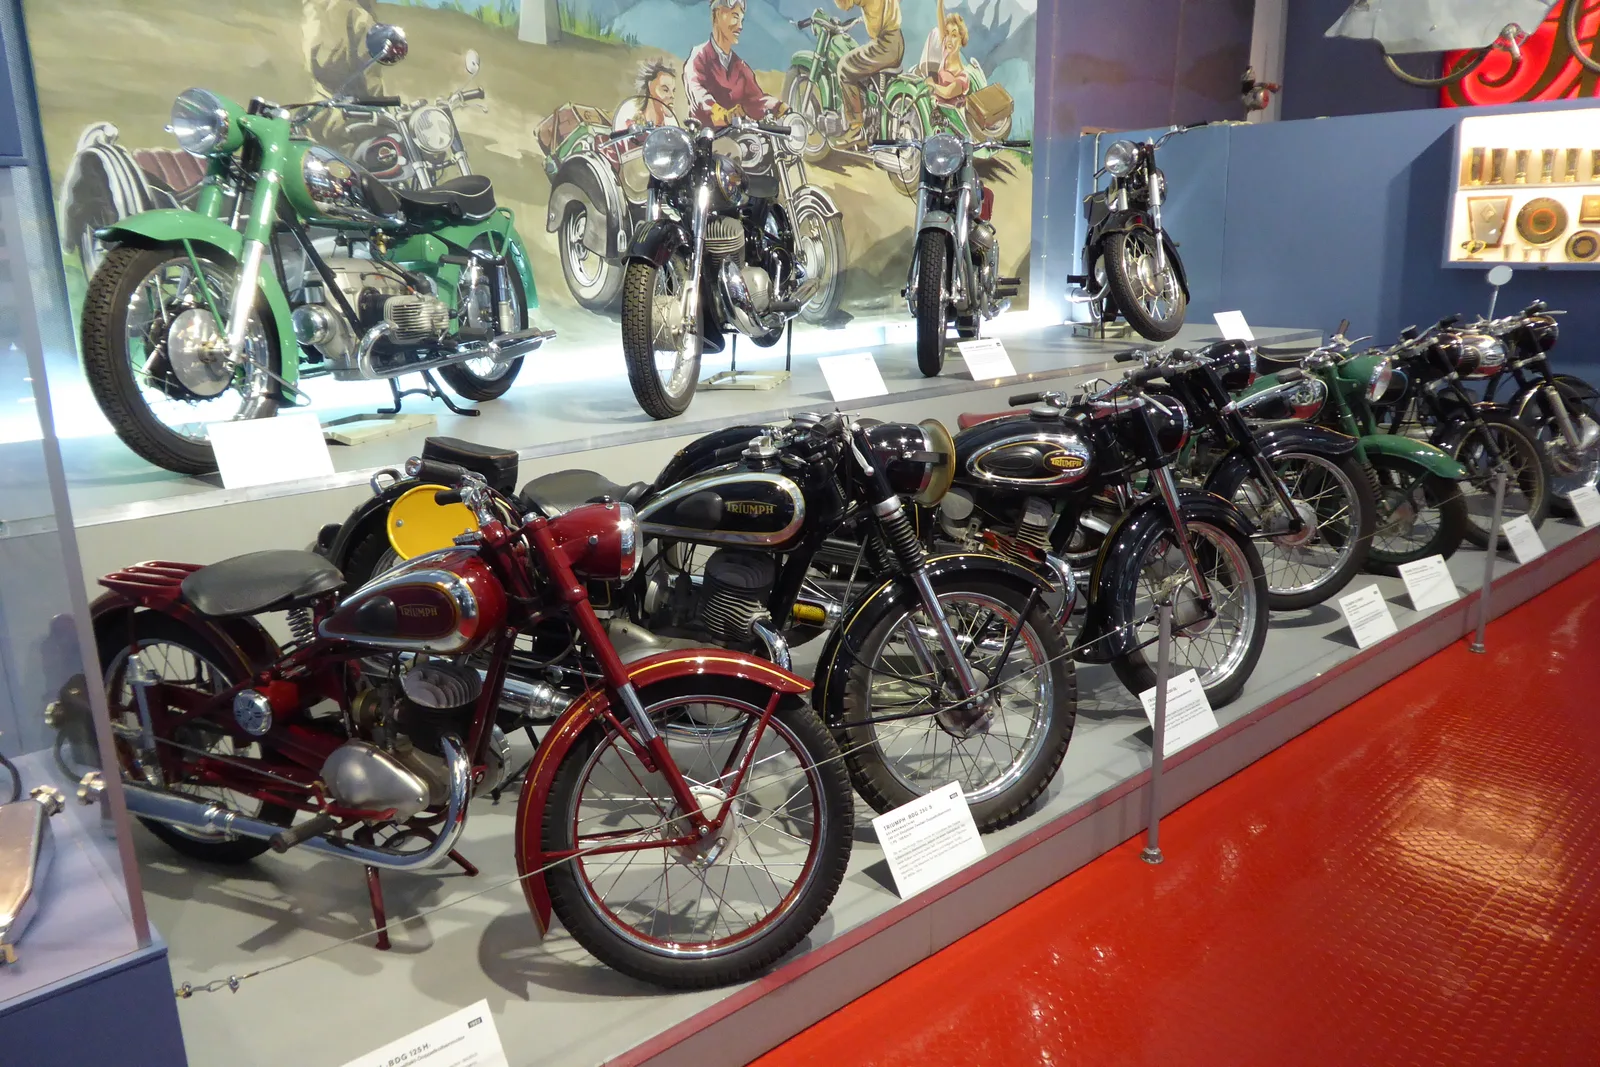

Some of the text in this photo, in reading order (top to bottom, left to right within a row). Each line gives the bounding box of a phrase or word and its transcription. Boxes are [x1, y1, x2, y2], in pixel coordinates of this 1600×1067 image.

[1050, 456, 1083, 468] TRIUMPH
[724, 500, 778, 515] TRIUMPH
[398, 603, 439, 617] TRIUMPH
[883, 817, 906, 831] TRIUMPH
[388, 1053, 408, 1067] BDG
